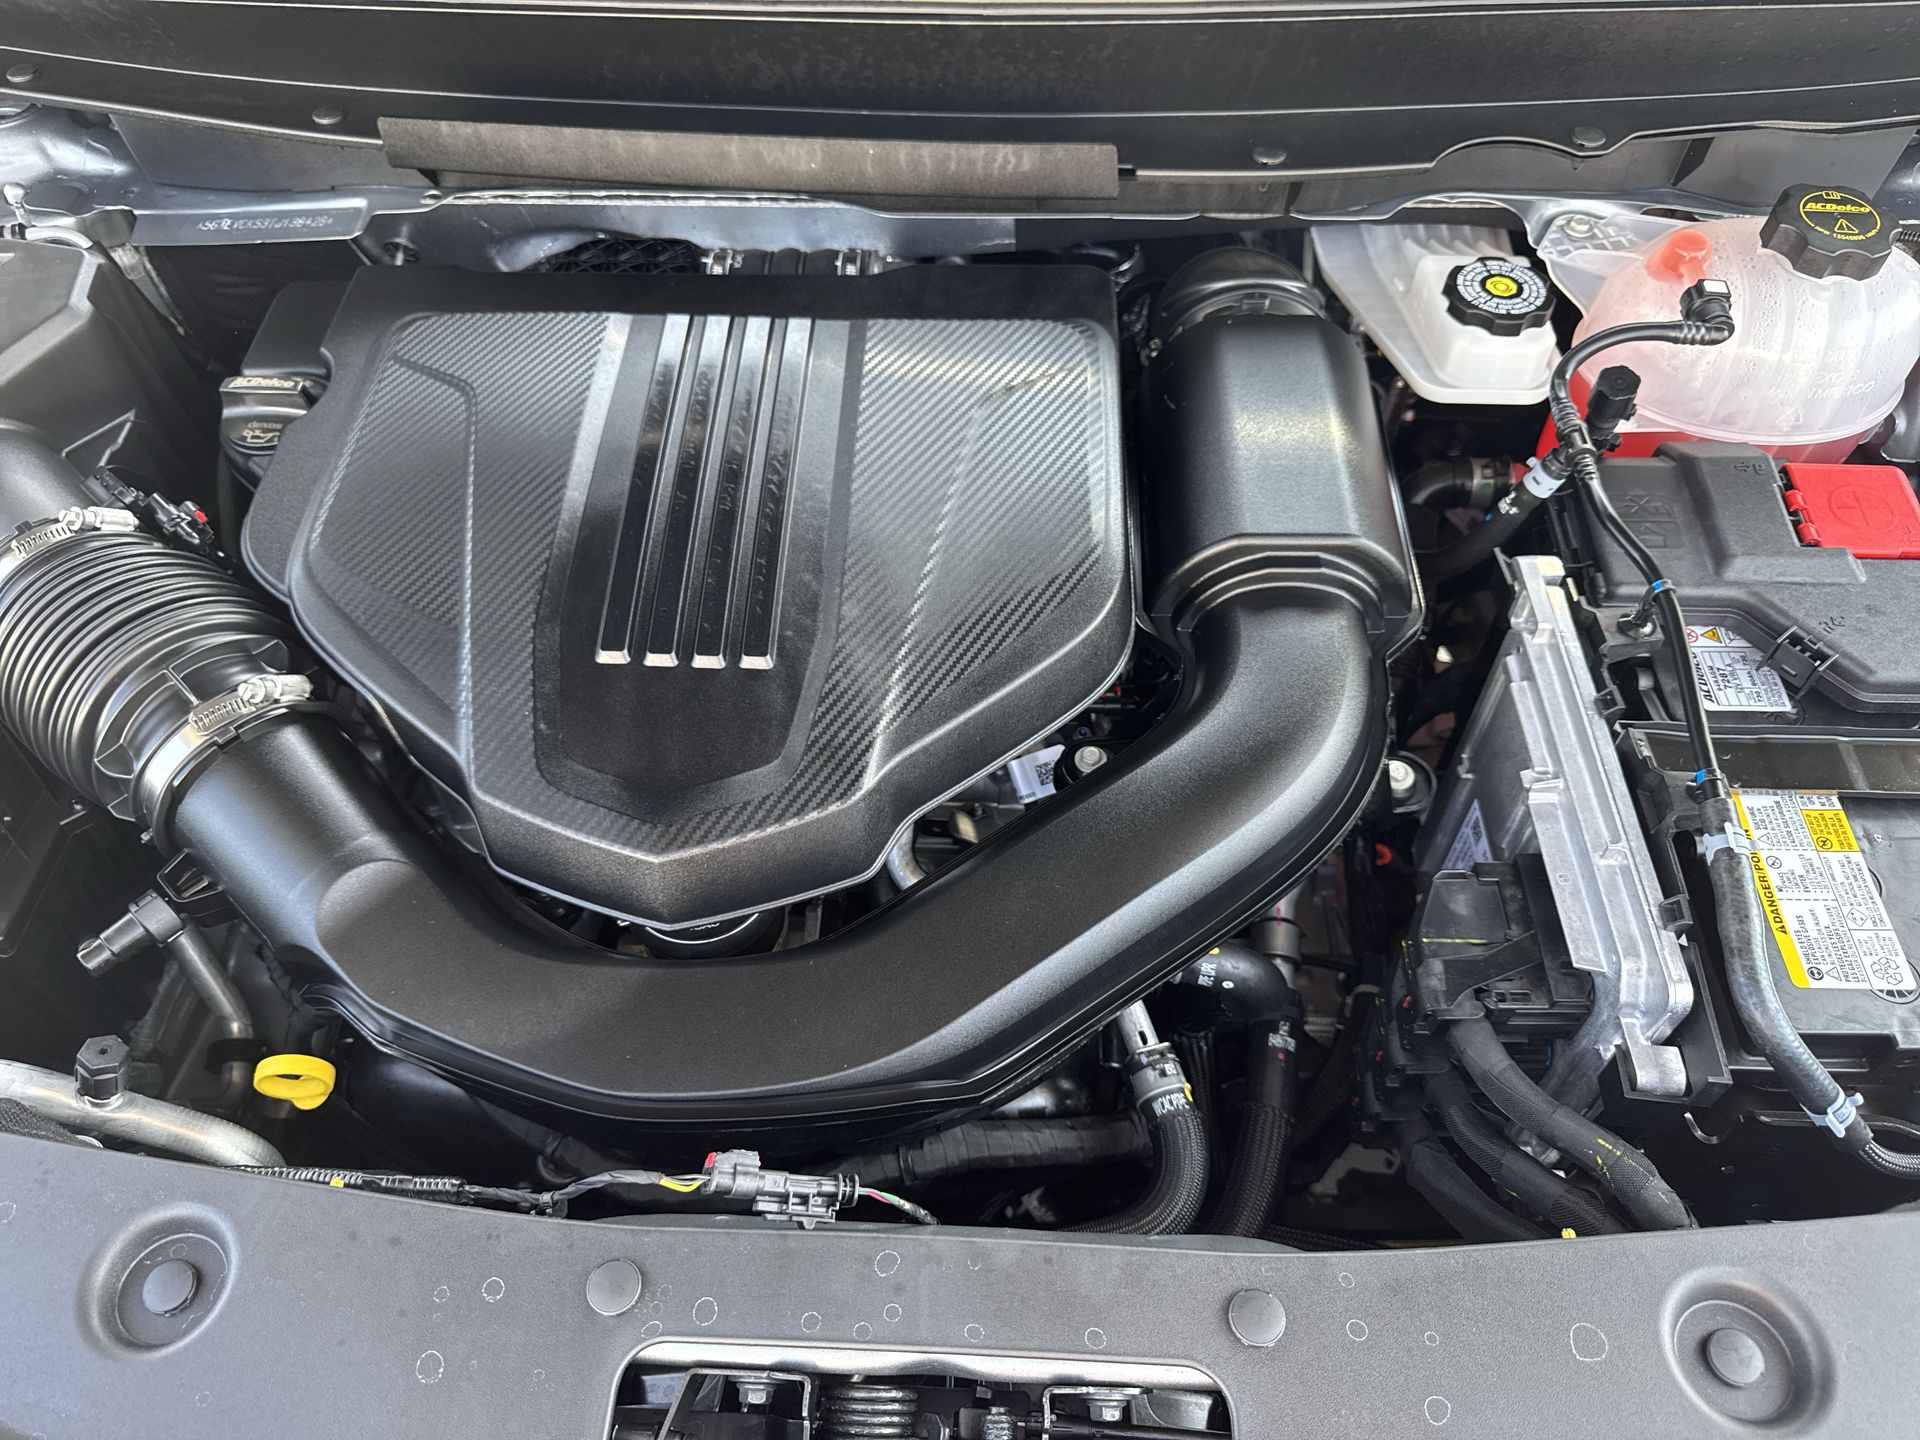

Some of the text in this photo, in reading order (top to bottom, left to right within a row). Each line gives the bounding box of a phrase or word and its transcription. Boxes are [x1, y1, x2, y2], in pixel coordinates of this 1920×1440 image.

[1804, 202, 1871, 213] ACDelco
[228, 377, 296, 389] ACDelco
[247, 421, 286, 430] dexos
[1716, 667, 1733, 689] 7287
[1724, 662, 1738, 680] VRLA
[1732, 682, 1744, 693] 12V
[1746, 805, 1761, 830] SULFURIC
[1754, 807, 1769, 830] ACID CAN
[1793, 929, 1813, 964] SHIELD EYES
[1794, 914, 1821, 964] EXPLOSIVE GASES
[1829, 941, 1840, 951] LES
[1832, 927, 1850, 958] EXPLOSIFS
[1812, 936, 1828, 965] CAN CAUSE
[1819, 936, 1836, 965] BLINDNESS
[1844, 959, 1855, 970] GAZ
[1849, 972, 1860, 982] LES
